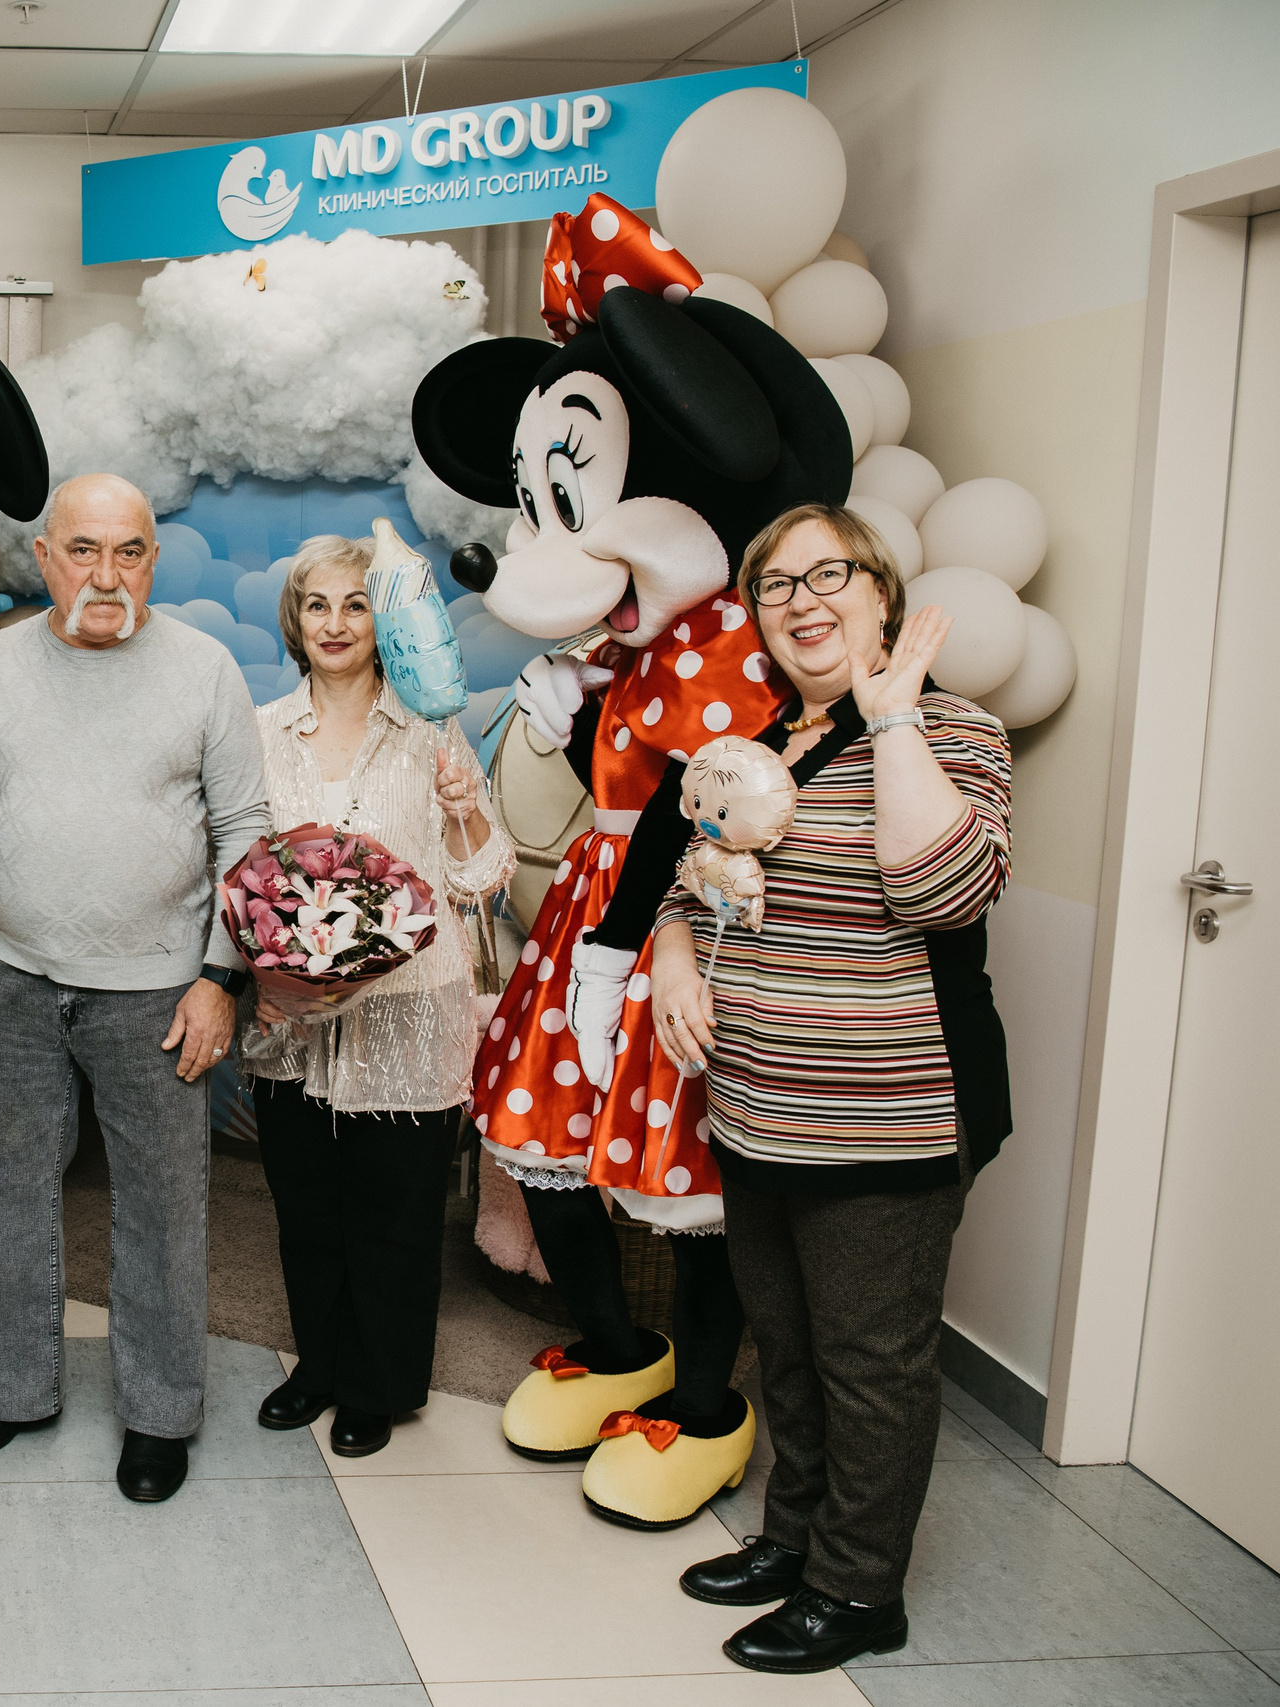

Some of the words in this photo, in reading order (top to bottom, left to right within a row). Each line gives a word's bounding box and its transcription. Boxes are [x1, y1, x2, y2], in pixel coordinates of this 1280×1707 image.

[311, 125, 402, 180] MD
[411, 94, 612, 168] GROUP
[318, 175, 470, 214] КЛИНИЧЕСКИЙ
[475, 163, 608, 197] ГОСПИТАЛЬ
[390, 660, 423, 693] boy
